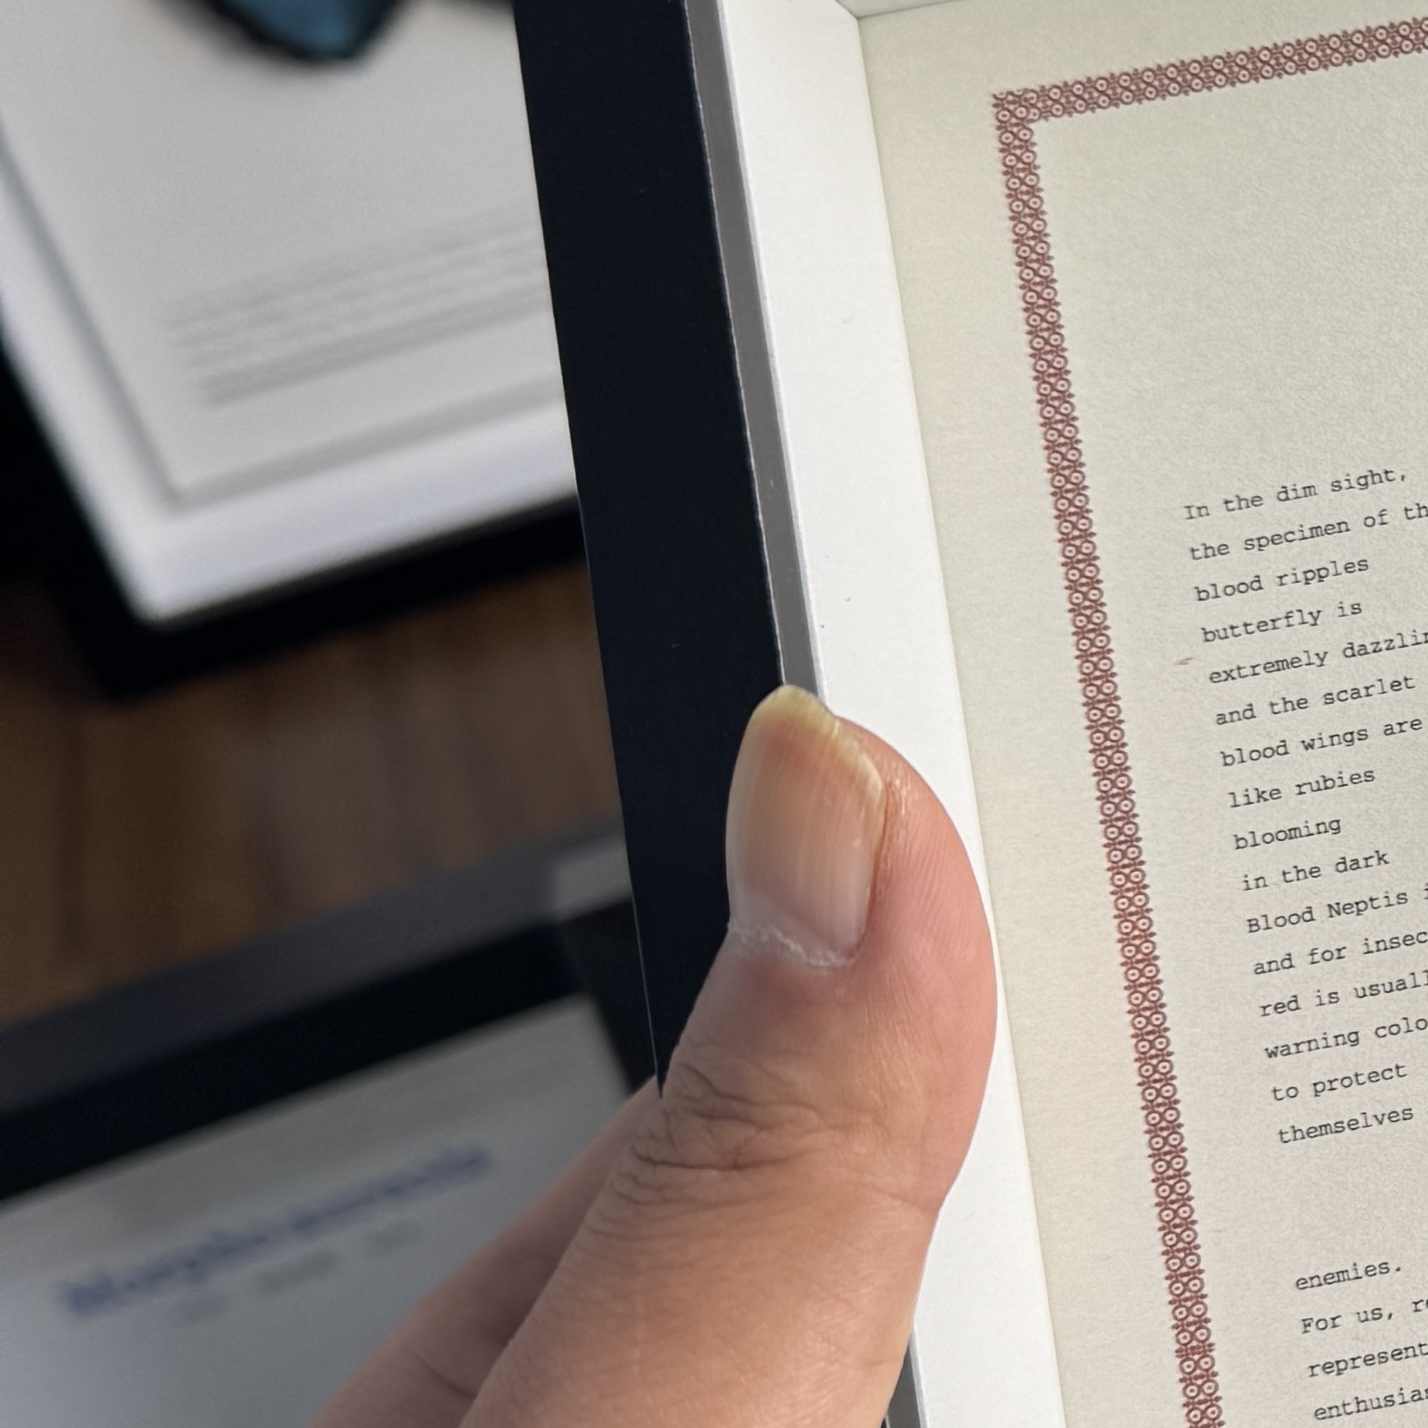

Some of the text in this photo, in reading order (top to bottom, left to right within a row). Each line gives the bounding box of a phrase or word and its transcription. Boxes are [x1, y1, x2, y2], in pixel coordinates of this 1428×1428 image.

[1183, 468, 1406, 521] In the dim sight,
[1189, 542, 1231, 561] the
[1243, 520, 1352, 552] specimen
[1362, 508, 1389, 529] of
[1193, 558, 1370, 602] blood ripples
[1199, 600, 1363, 643] butterfly is
[1208, 649, 1329, 684] extremely
[1215, 675, 1417, 726] and the scarlet
[1219, 718, 1423, 768] blood wings are
[1227, 769, 1377, 809] like rubies
[1232, 818, 1342, 851] blooming
[1241, 849, 1391, 892] in the dark
[1245, 905, 1317, 934] Blood
[1325, 890, 1409, 919] Neptis
[1253, 951, 1297, 976] and
[1307, 945, 1348, 966] for
[1258, 994, 1303, 1018] red
[1315, 988, 1341, 1007] is
[1263, 1030, 1360, 1059] warning
[1270, 1063, 1408, 1102] to protect
[1277, 1107, 1414, 1144] themselves
[1294, 1261, 1402, 1291] enemies.
[1300, 1314, 1343, 1335] For
[1354, 1307, 1394, 1324] us,
